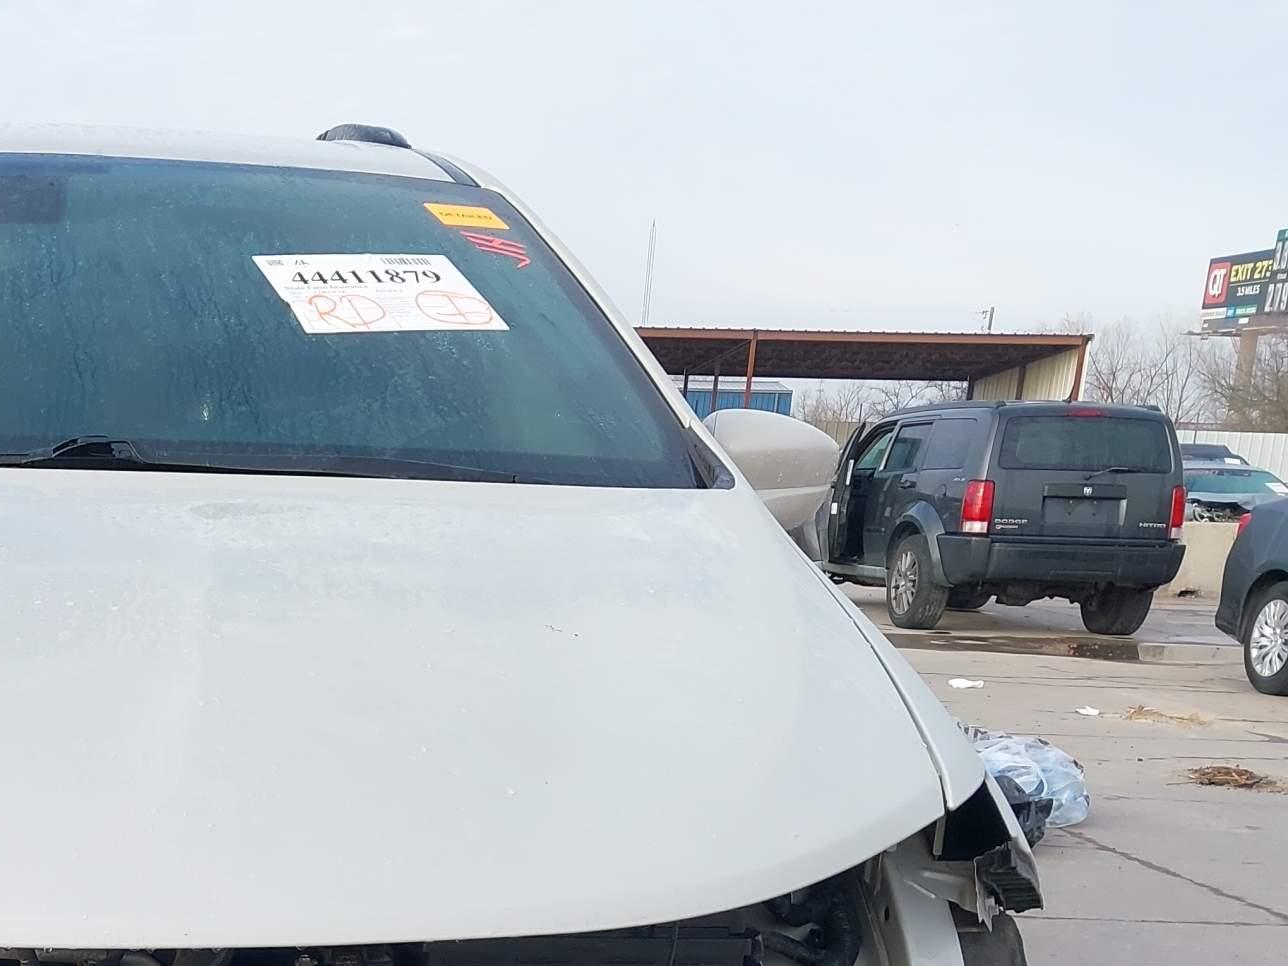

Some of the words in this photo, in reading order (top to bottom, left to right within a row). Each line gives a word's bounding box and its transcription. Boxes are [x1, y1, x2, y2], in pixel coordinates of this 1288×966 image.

[291, 268, 441, 285] 44411879
[1230, 262, 1254, 282] EXIT
[1208, 268, 1226, 297] QT
